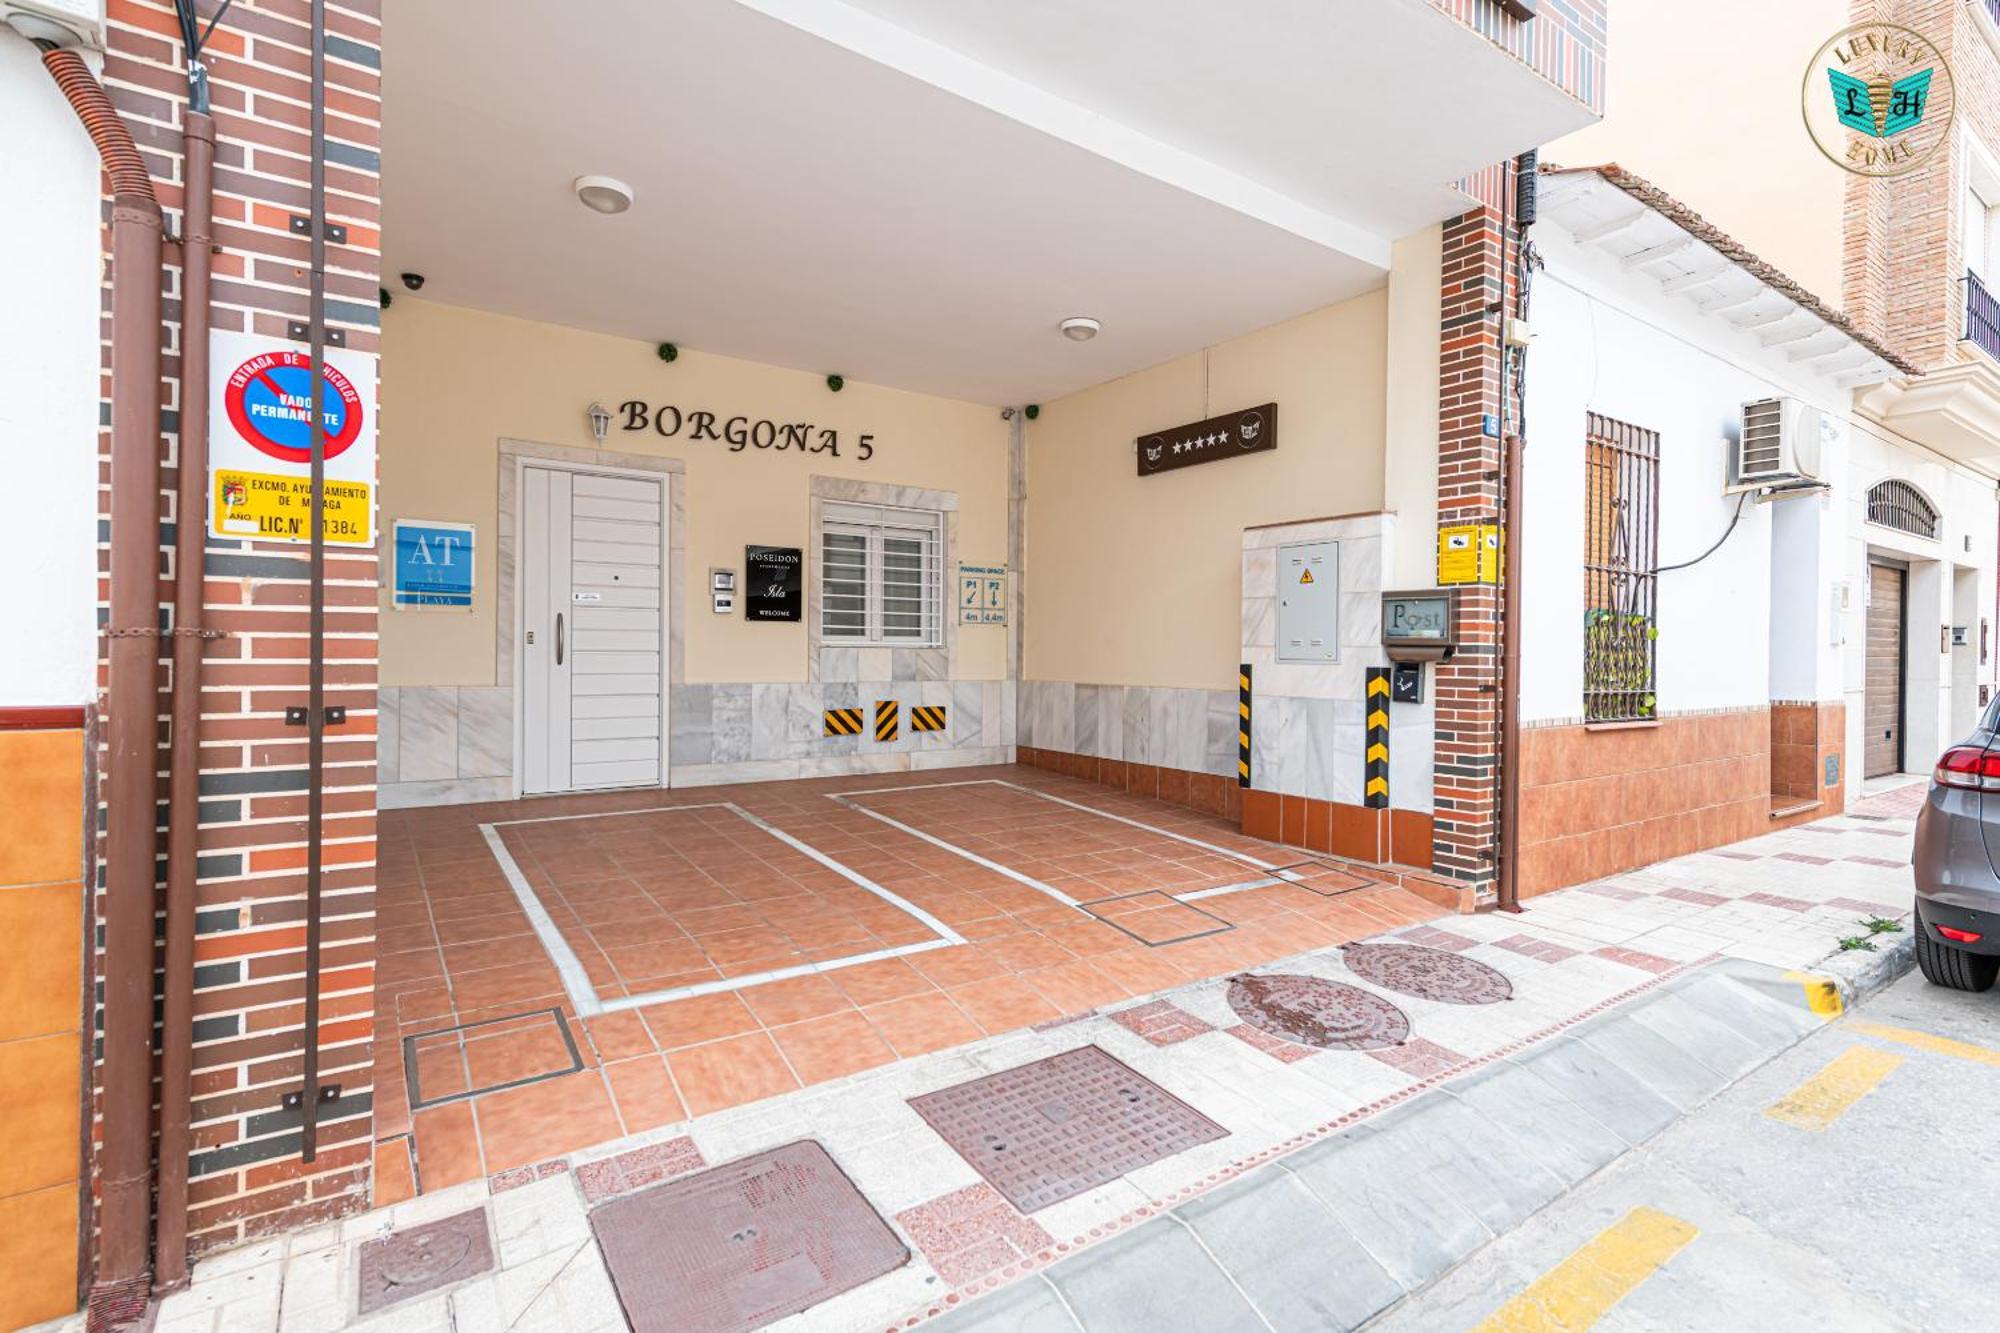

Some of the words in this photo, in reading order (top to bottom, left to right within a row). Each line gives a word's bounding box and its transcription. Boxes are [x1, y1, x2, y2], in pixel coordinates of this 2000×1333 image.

[230, 354, 276, 389] ENTRADA
[283, 353, 299, 365] DE
[322, 364, 358, 404] HICULOS
[279, 393, 312, 409] VADO
[619, 401, 841, 457] BORGOÑA
[857, 435, 874, 460] 5
[251, 479, 290, 493] EXCMO.
[292, 483, 367, 500] AYUAMIENTO
[278, 495, 291, 506] DE
[301, 497, 341, 510] MAGA
[407, 533, 460, 566] AT
[749, 552, 799, 564] POSEIDON
[759, 609, 790, 617] WELCOME
[1392, 604, 1440, 629] Post
